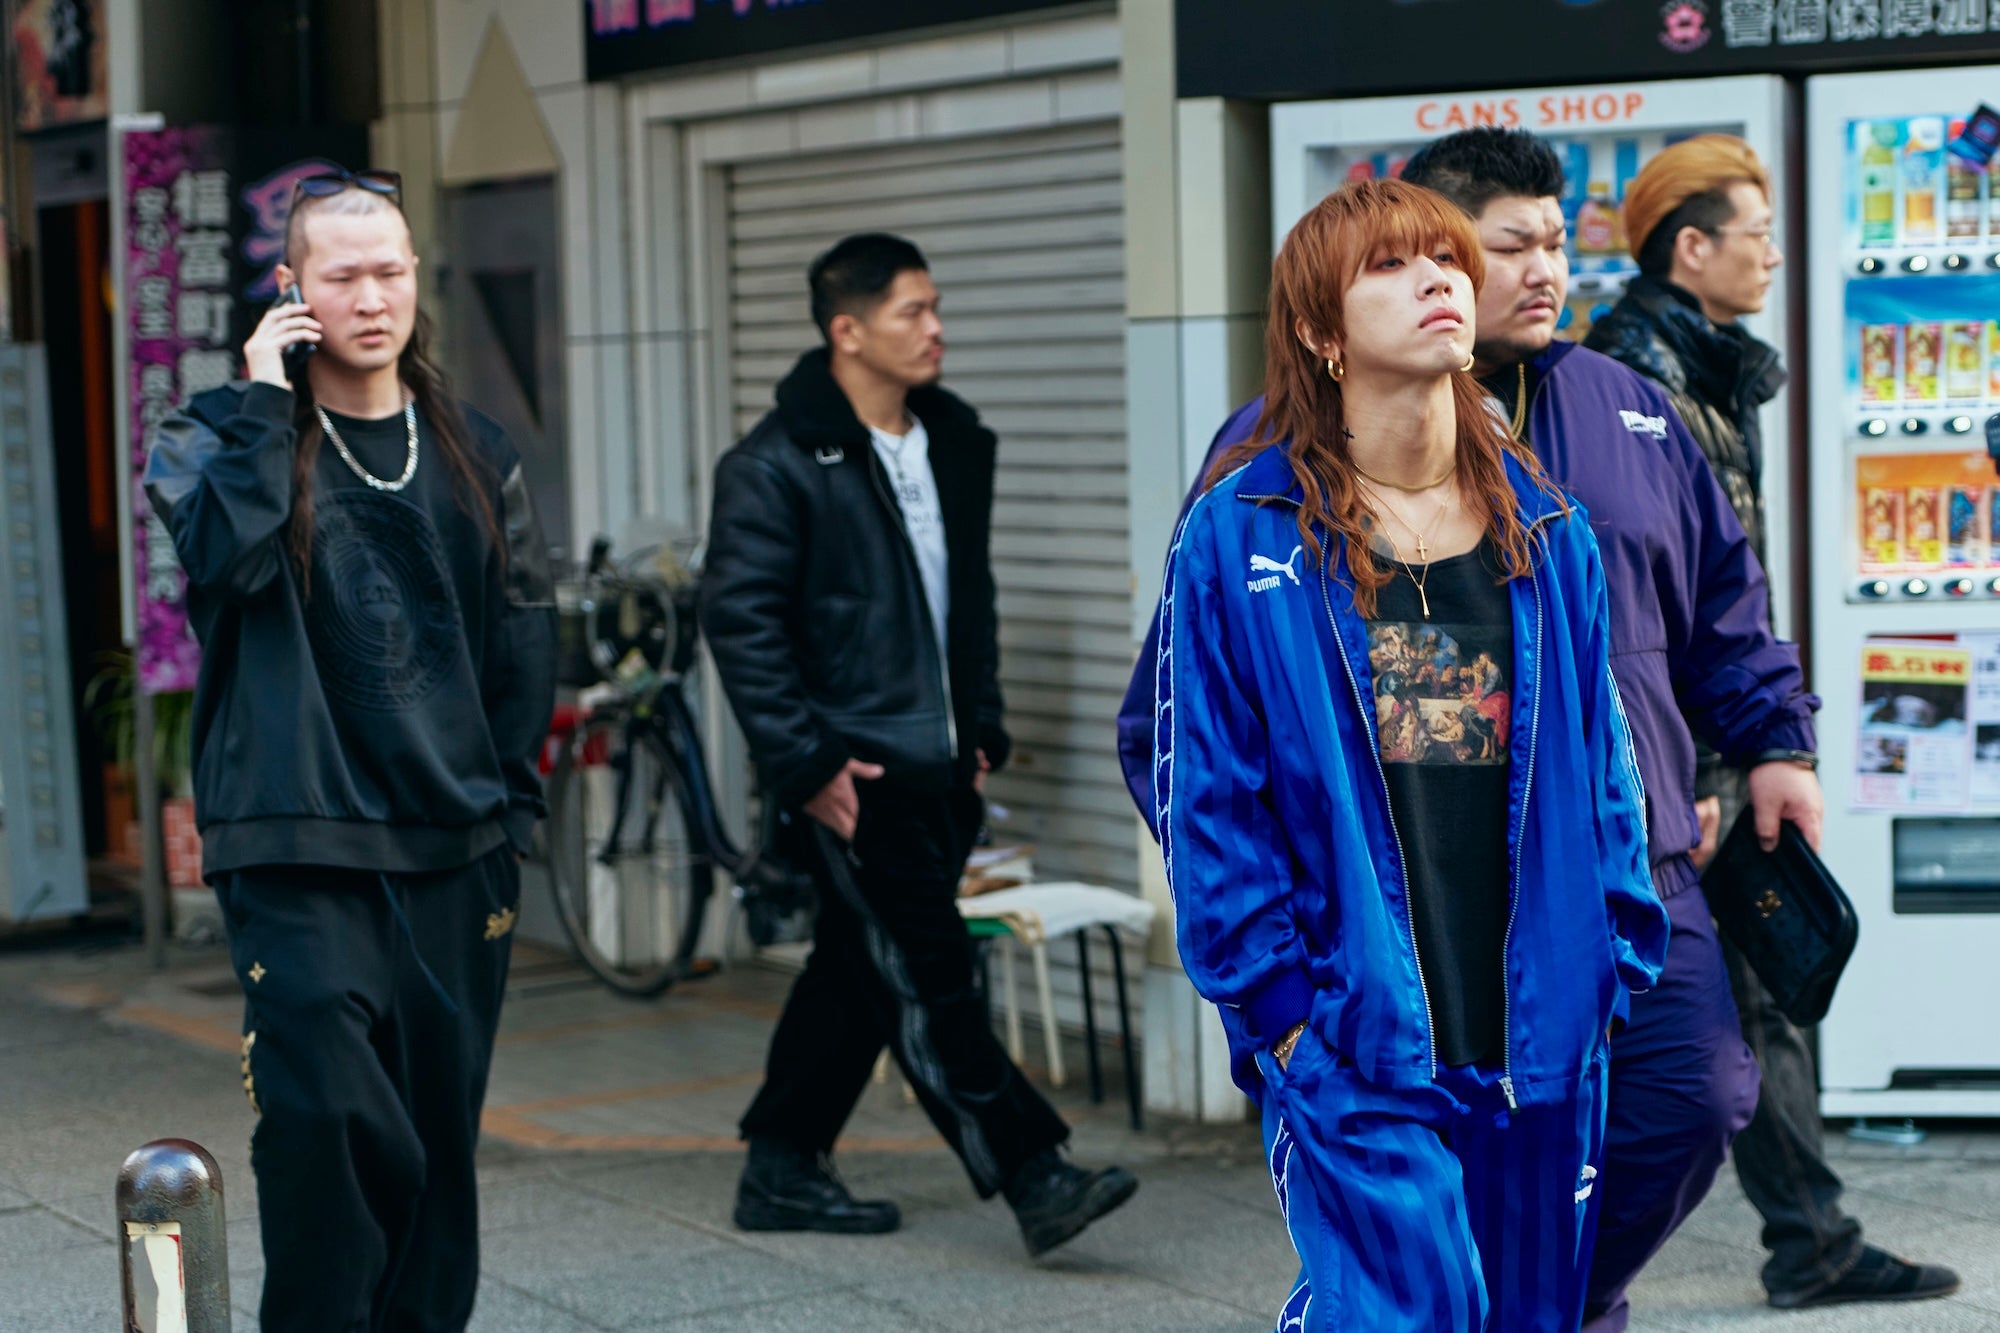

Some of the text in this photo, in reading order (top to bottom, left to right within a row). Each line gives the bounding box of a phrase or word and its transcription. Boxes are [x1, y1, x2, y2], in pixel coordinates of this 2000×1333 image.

[1722, 0, 2000, 47] 警備保障加
[1415, 92, 1643, 131] CANS SHOP
[1247, 575, 1280, 593] PUMA
